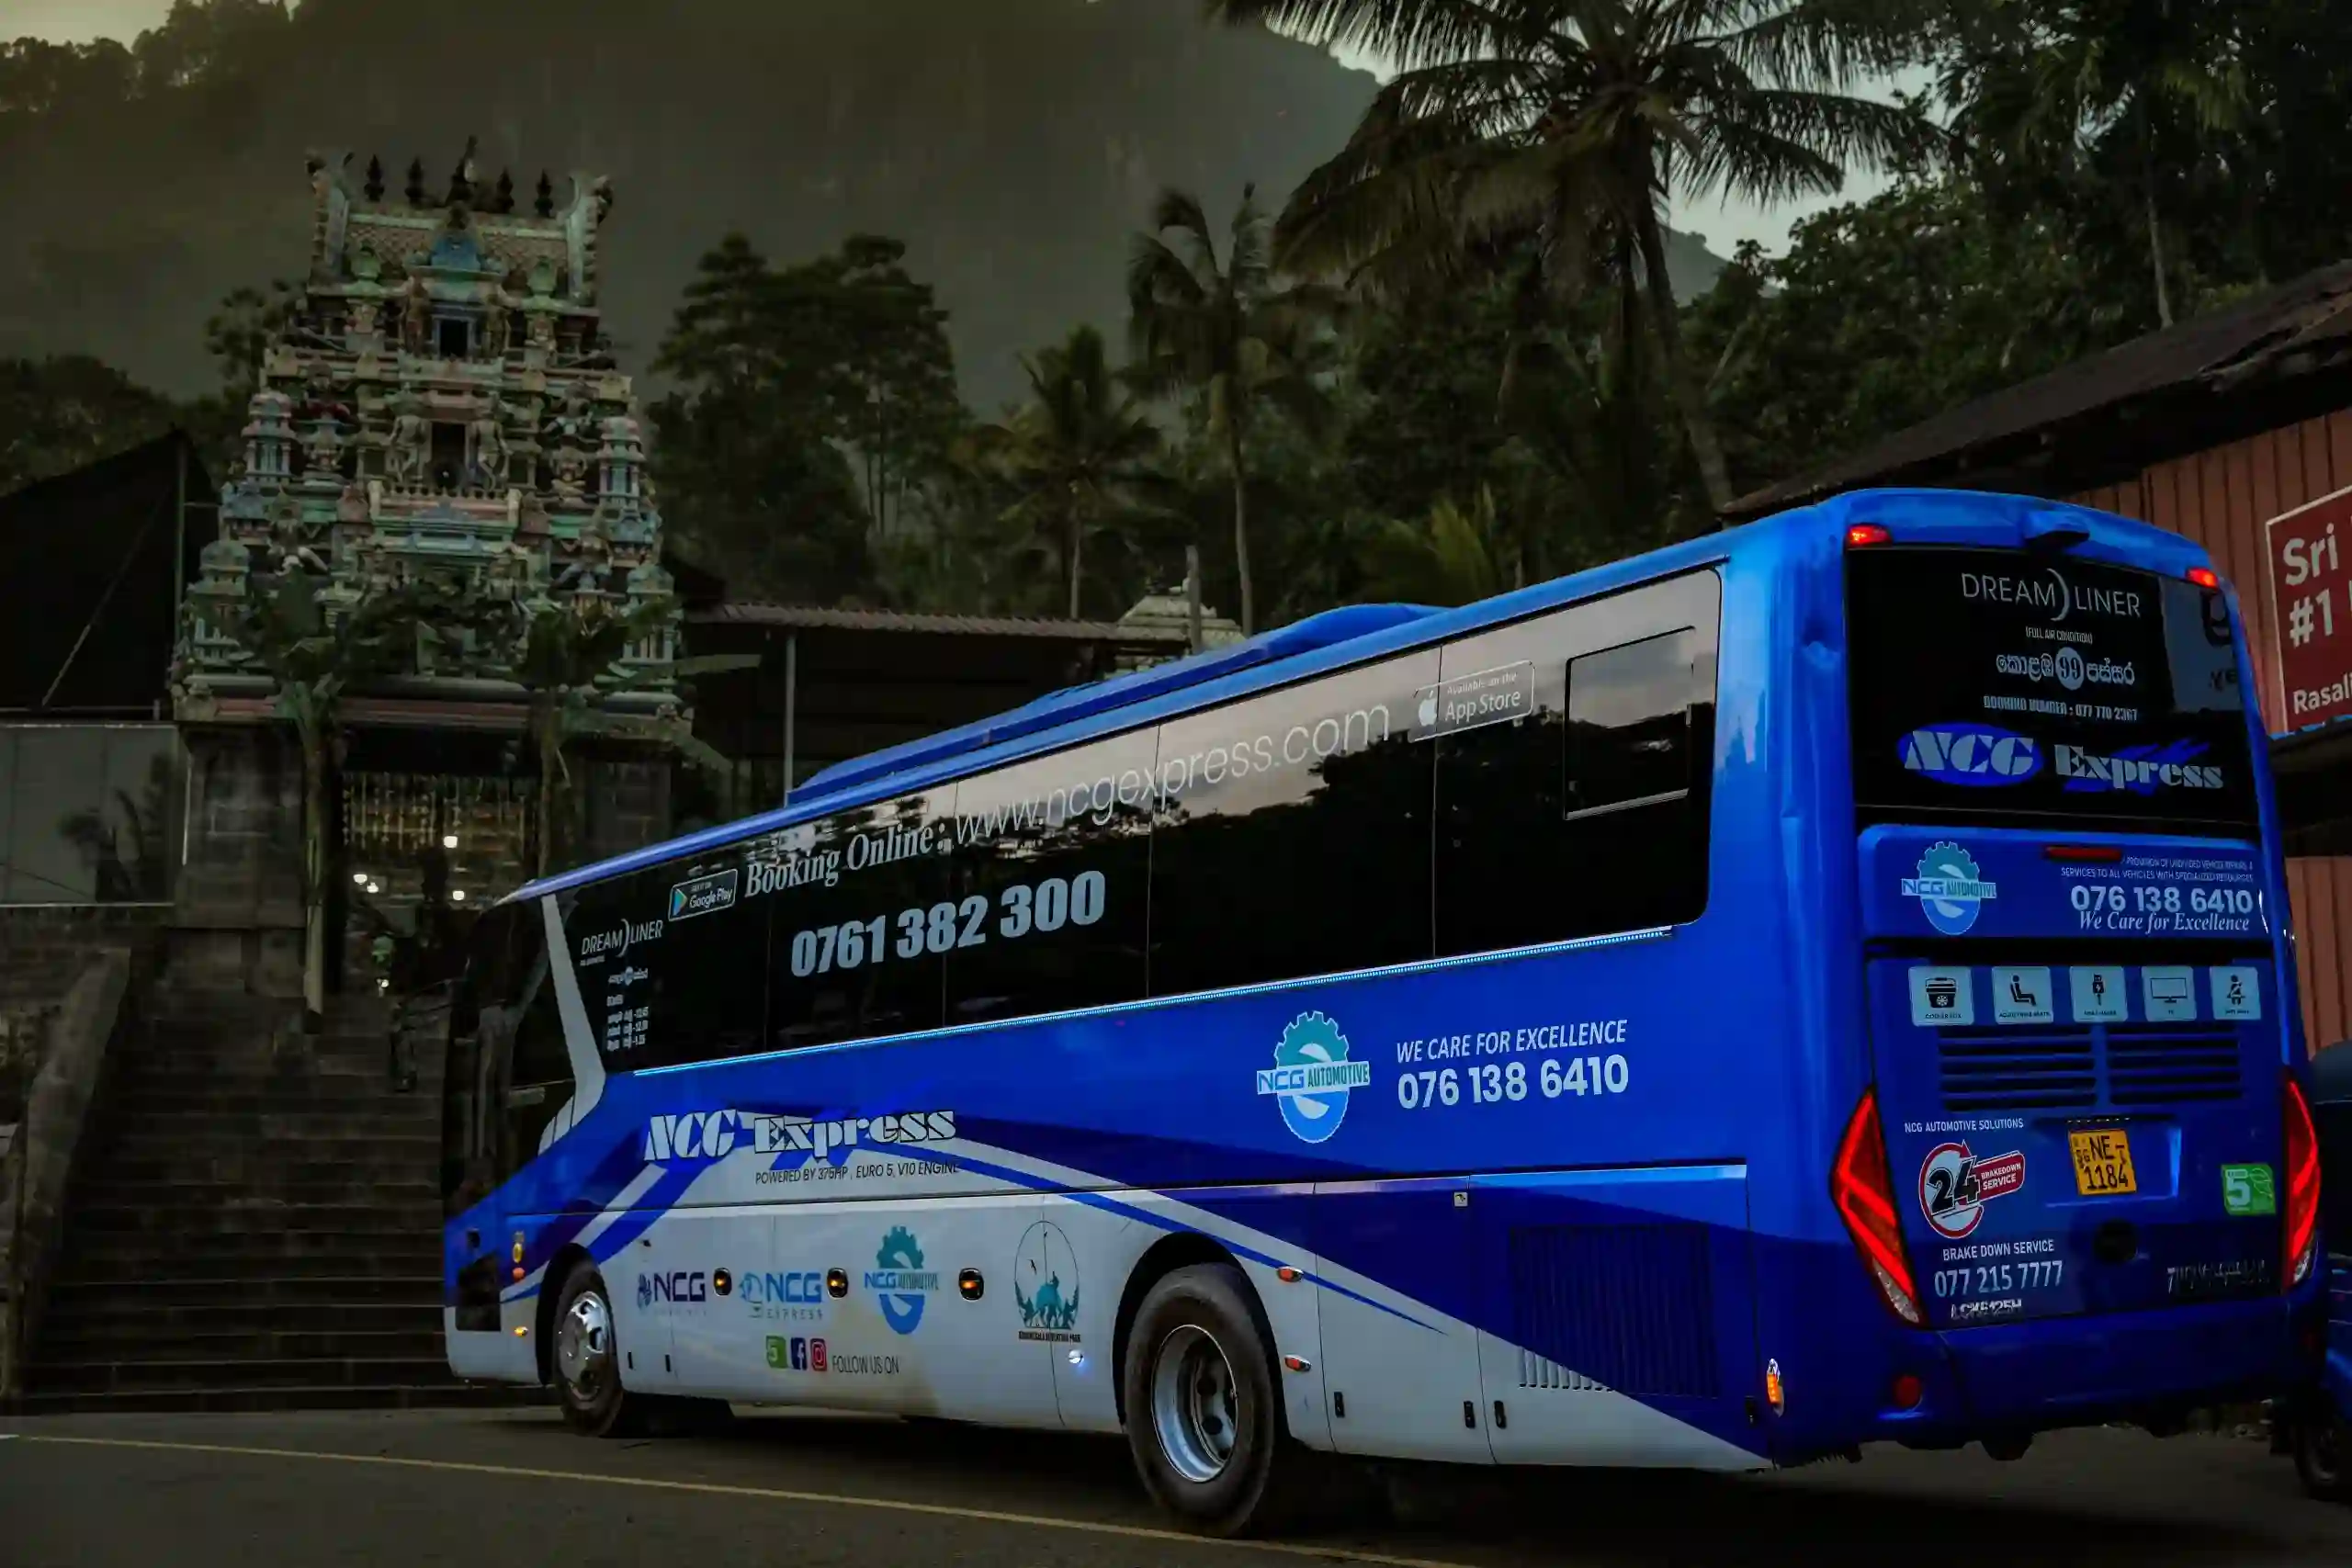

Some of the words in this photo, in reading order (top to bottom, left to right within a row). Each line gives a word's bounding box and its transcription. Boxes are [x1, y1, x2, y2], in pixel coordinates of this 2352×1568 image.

[2283, 523, 2339, 587] Sri
[2075, 585, 2141, 618] LINER
[2290, 588, 2334, 649] #1
[1444, 701, 1477, 725] App
[1479, 691, 1521, 716] Store
[1904, 729, 2034, 776] NCG
[2053, 743, 2224, 791] Express
[743, 849, 841, 898] Booking
[954, 704, 1390, 844] www.ncgexpress.com
[1903, 881, 1945, 895] NCG
[2071, 885, 2126, 911] 076
[2133, 886, 2181, 912] 138
[2190, 887, 2254, 914] 6410
[628, 919, 663, 944] LINER
[790, 915, 887, 978] 0761
[896, 894, 989, 959] 382
[1000, 870, 1107, 939] 300
[2080, 909, 2102, 930] We
[2108, 911, 2143, 930] Care
[2144, 911, 2170, 935] for
[2173, 912, 2250, 931] Excellence
[1396, 1040, 1423, 1064] WE
[1427, 1034, 1472, 1060] CARE
[1476, 1031, 1511, 1055] FOR
[1516, 1019, 1628, 1052] EXCELLENCE
[1258, 1069, 1304, 1092] NCG
[1307, 1064, 1369, 1088] AUTOMOTIVE
[1397, 1067, 1460, 1110] 076
[1468, 1061, 1527, 1103] 138
[1540, 1054, 1629, 1099] 6410
[643, 1109, 737, 1162] NCG
[754, 1110, 956, 1159] Express
[1904, 1122, 1923, 1133] NCG
[1926, 1120, 1977, 1132] AUTOMOTIVE
[1978, 1117, 2024, 1131] SOLUTIONS
[755, 1169, 800, 1184] POWERED
[803, 1168, 816, 1180] BY
[856, 1164, 883, 1179] EURO
[897, 1162, 915, 1176] V10
[1926, 1156, 1980, 1215] 24
[1982, 1173, 2017, 1190] SERVICE
[2084, 1164, 2129, 1189] 1184
[1943, 1246, 1978, 1261] BRAKE
[1981, 1242, 2011, 1257] DOWN
[2013, 1239, 2055, 1254] SERVICE
[654, 1273, 706, 1302] NCG
[765, 1273, 822, 1303] NCG
[865, 1272, 897, 1289] NCG
[1934, 1269, 1971, 1298] 077
[1977, 1264, 2012, 1293] 215
[2018, 1260, 2063, 1289] 7777
[832, 1355, 868, 1372] FOLLOW
[871, 1356, 883, 1373] US
[885, 1356, 899, 1373] ON
